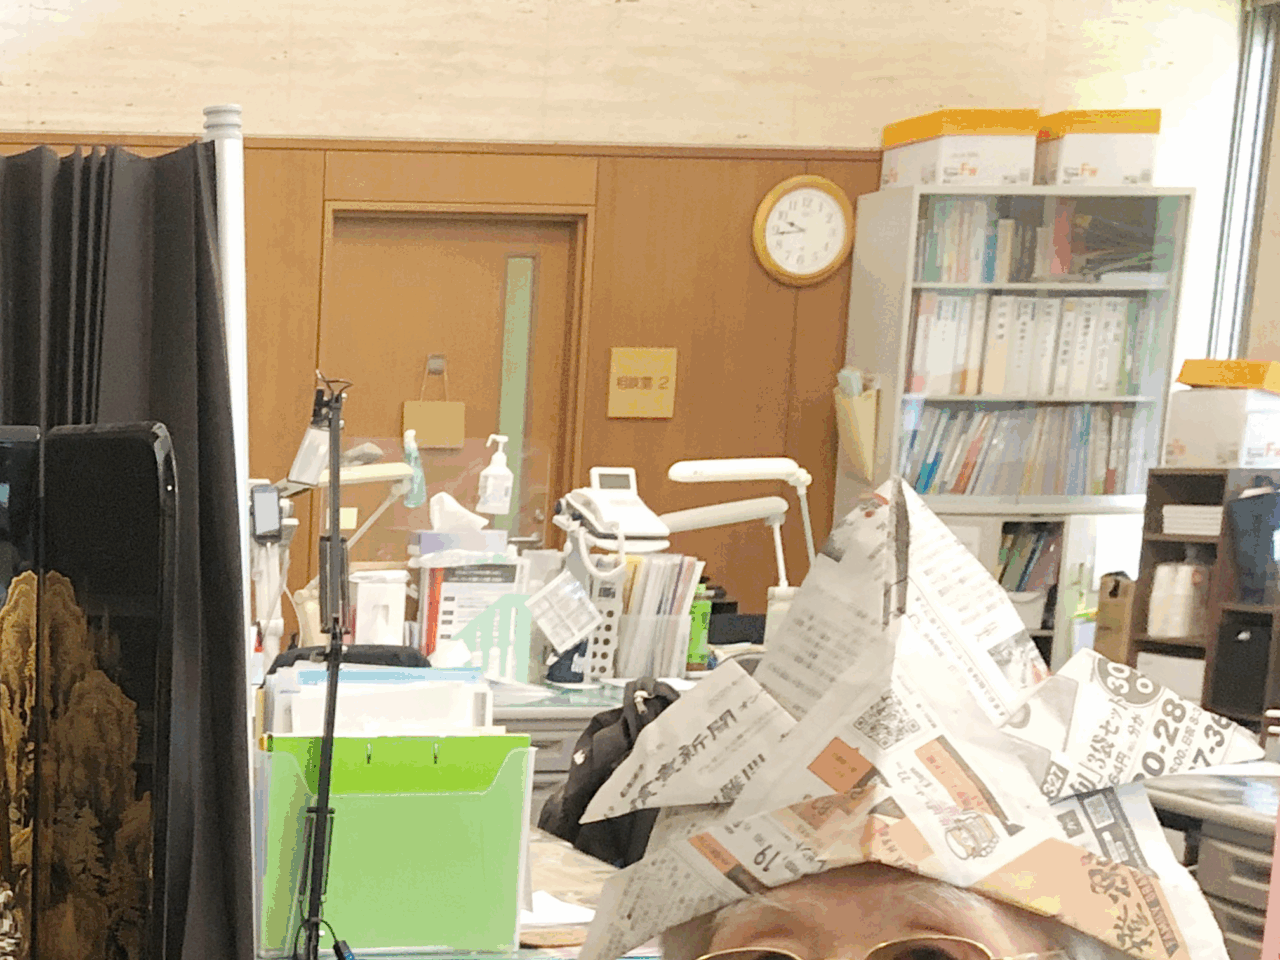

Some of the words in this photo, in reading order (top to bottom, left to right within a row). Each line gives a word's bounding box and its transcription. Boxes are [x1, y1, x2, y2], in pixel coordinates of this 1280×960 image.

[658, 375, 670, 391] 2
[1132, 697, 1187, 783] 0-28
[1187, 713, 1233, 770] 7-36
[1042, 765, 1066, 798] 327
